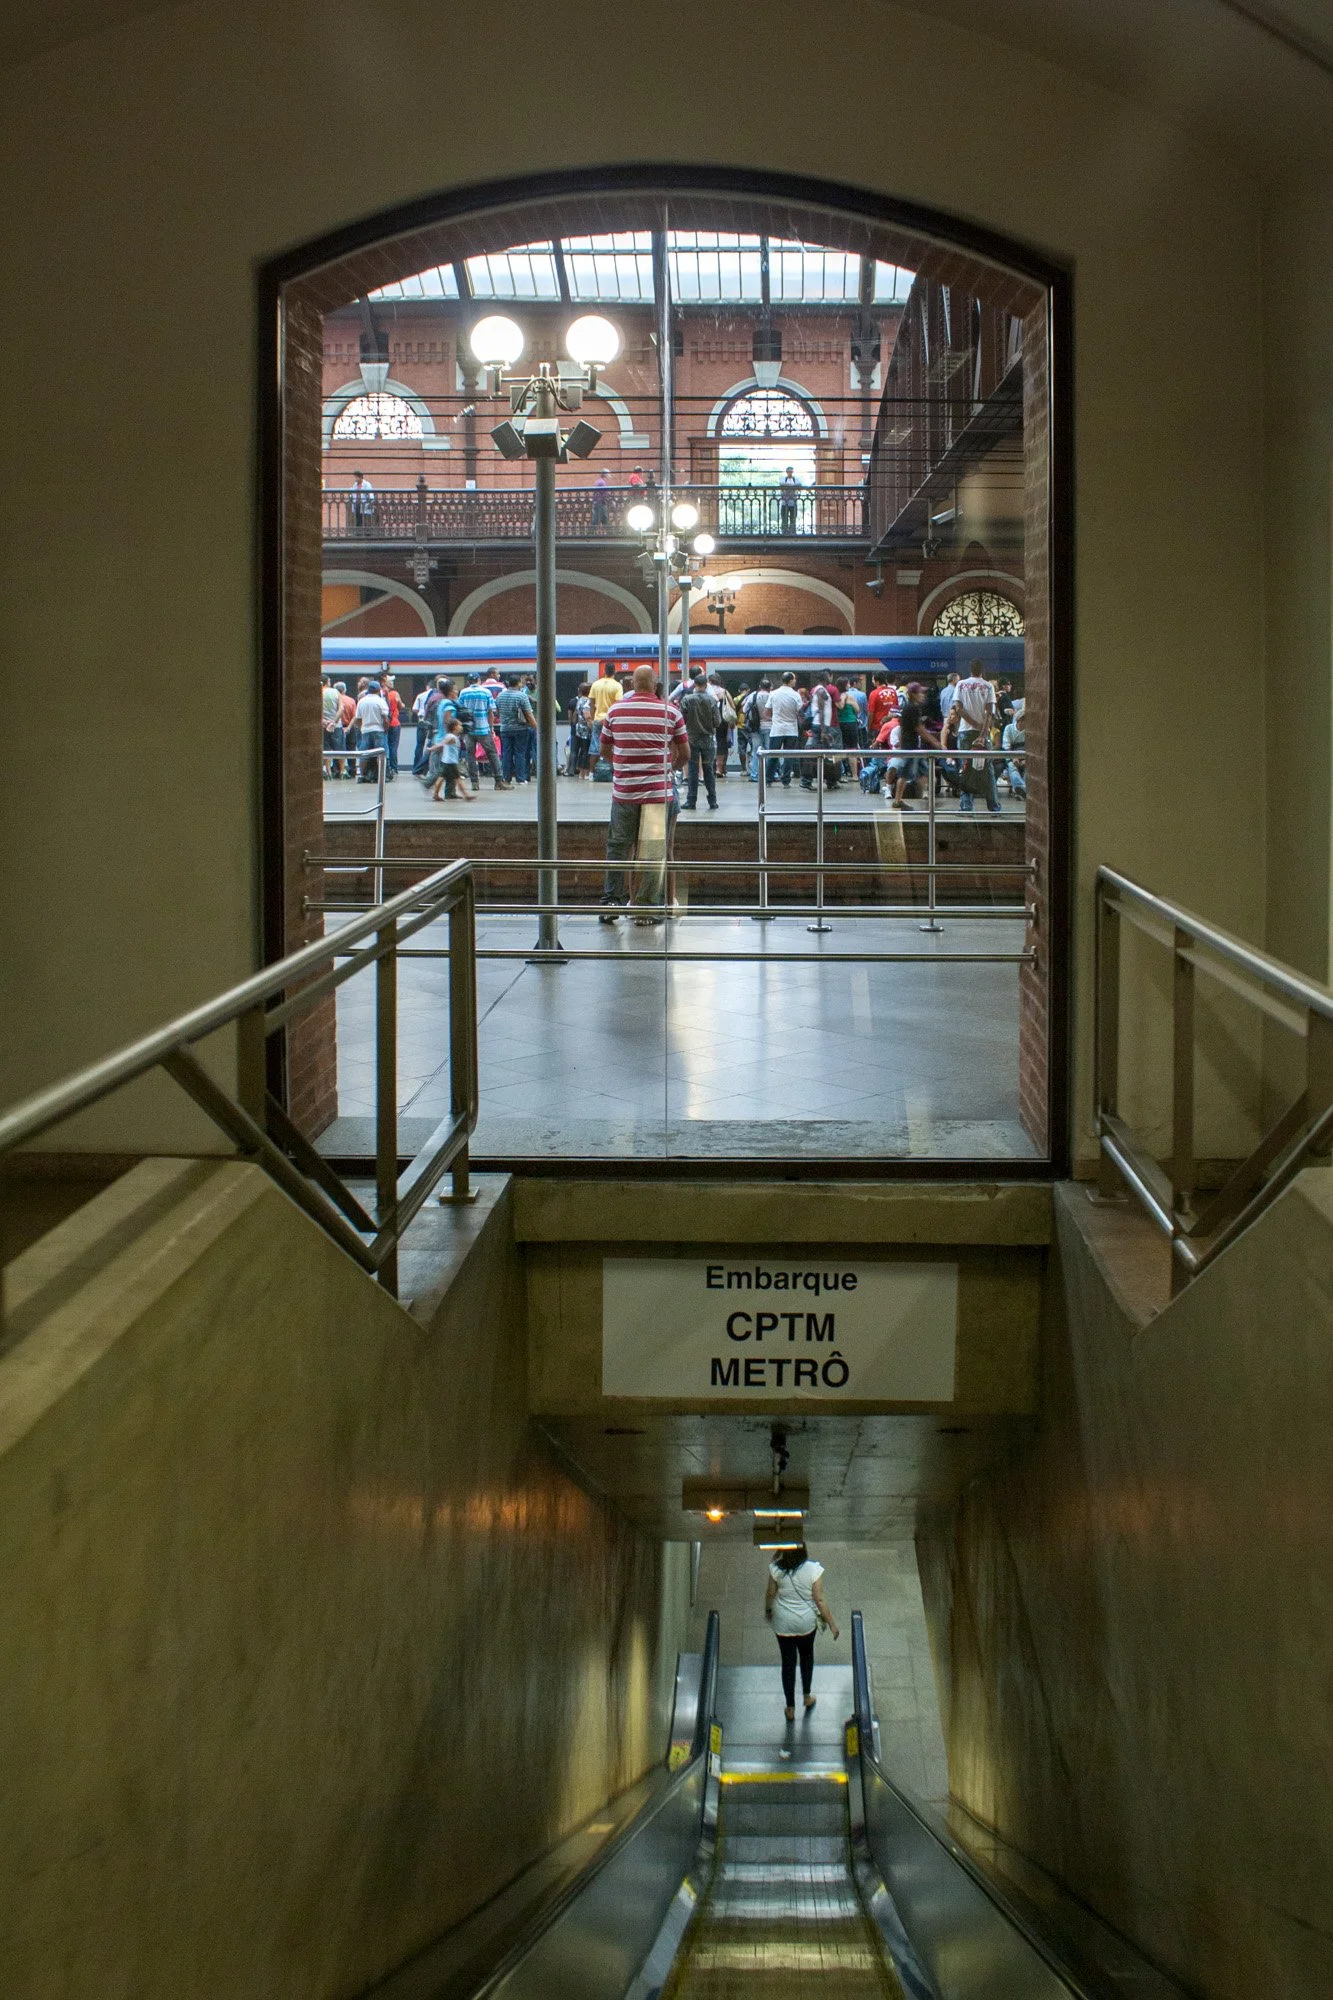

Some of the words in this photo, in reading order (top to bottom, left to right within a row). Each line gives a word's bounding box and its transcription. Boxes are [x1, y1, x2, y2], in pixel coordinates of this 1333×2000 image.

[705, 1265, 859, 1296] Embarque
[726, 1311, 836, 1342] CPTM
[710, 1351, 850, 1388] METRÔ
